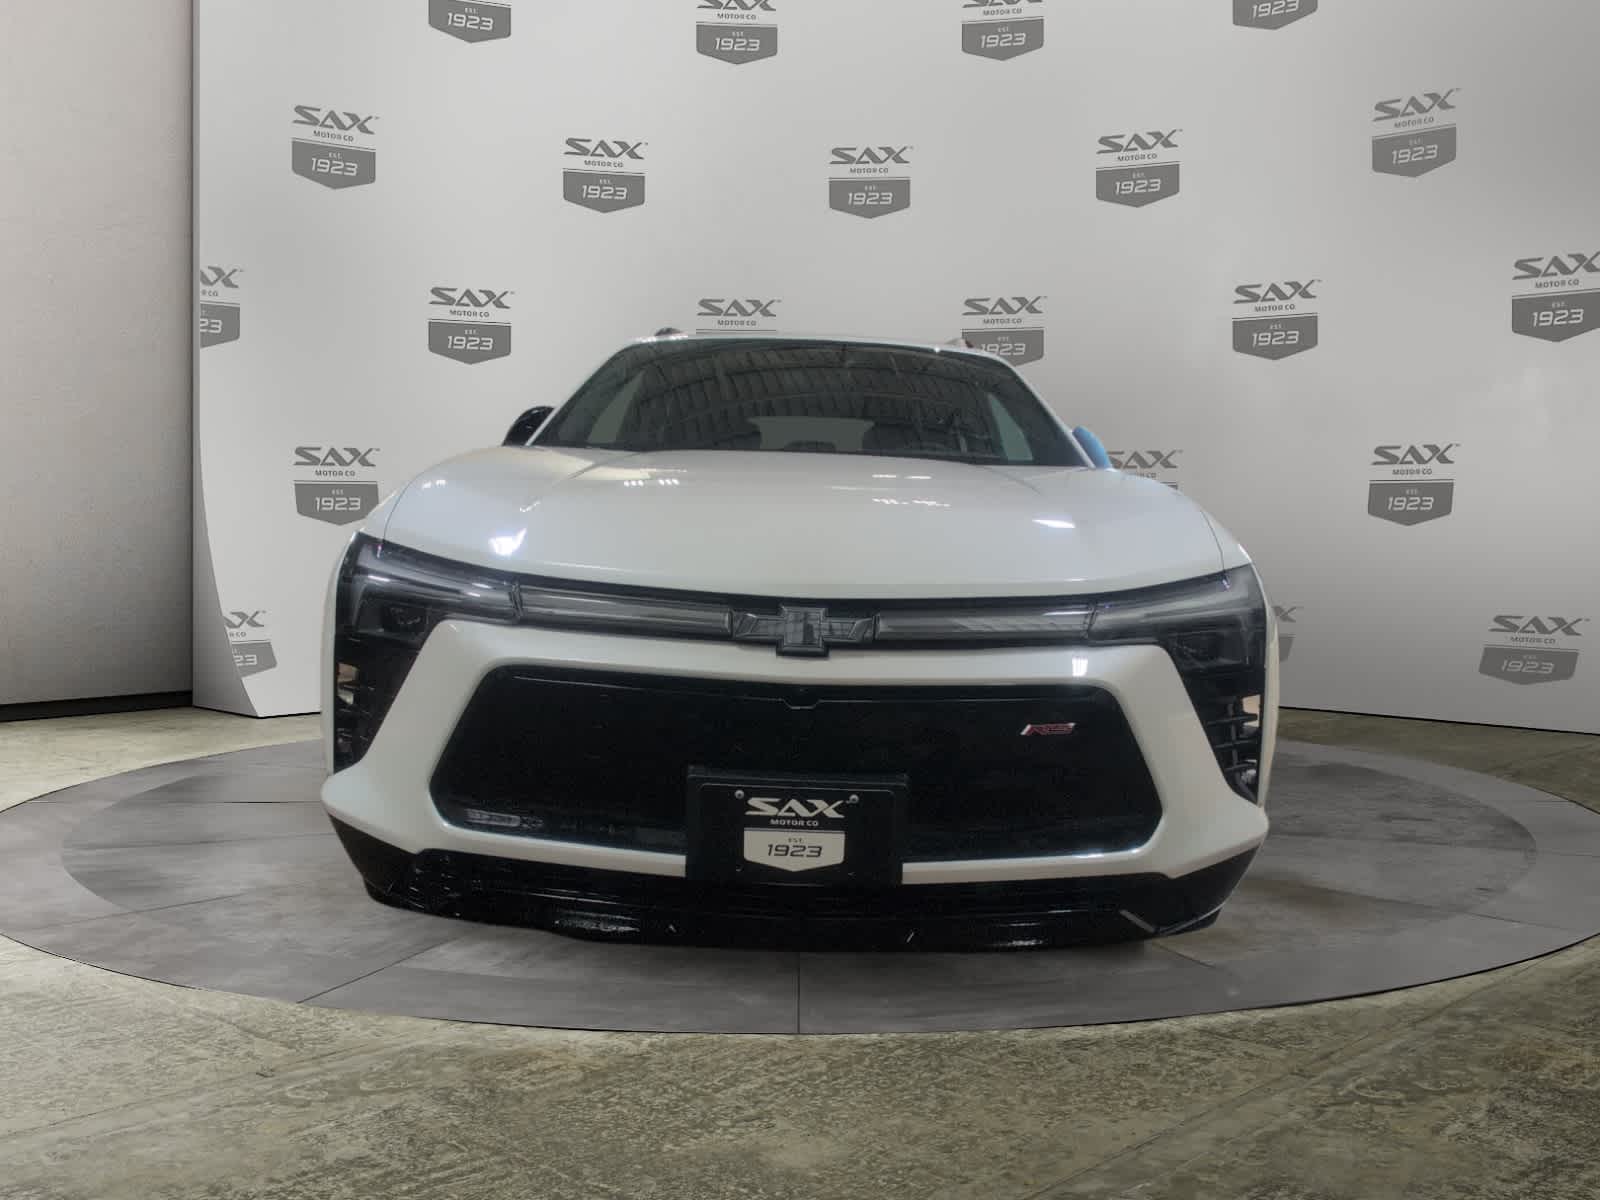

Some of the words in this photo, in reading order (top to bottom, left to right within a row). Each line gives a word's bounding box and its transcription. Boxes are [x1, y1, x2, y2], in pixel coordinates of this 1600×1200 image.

[1252, 0, 1299, 19] 1923
[447, 12, 493, 30] 1923
[715, 38, 760, 51] 1923
[981, 33, 1026, 48] 1923
[1372, 88, 1456, 122] SAX
[293, 105, 375, 134] SAX
[1394, 119, 1421, 128] MOTOR
[313, 130, 342, 139] MOTOR
[343, 134, 355, 142] CO
[1096, 129, 1178, 155] SAX
[563, 137, 645, 160] SAX
[829, 146, 911, 165] SAX
[1392, 144, 1439, 164] 1923
[311, 157, 358, 176] 1923
[583, 160, 612, 168] MOTOR
[1118, 154, 1144, 162] MOTOR
[581, 185, 628, 200] 1923
[1115, 178, 1161, 195] 1923
[847, 192, 893, 205] 1923
[1512, 251, 1600, 280] SAX
[1233, 279, 1318, 304] SAX
[1535, 280, 1566, 288] MOTOR
[428, 286, 511, 309] SAX
[962, 296, 1043, 315] SAX
[697, 298, 777, 317] SAX
[1255, 304, 1282, 312] MOTOR
[200, 318, 222, 333] 23
[1532, 308, 1584, 327] 1923
[447, 335, 493, 350] 1923
[1252, 330, 1299, 347] 1923
[294, 446, 376, 467] SAX
[1372, 443, 1457, 465] SAX
[314, 496, 361, 511] 1923
[1388, 496, 1435, 511] 1923
[1488, 616, 1582, 635] SAX
[233, 654, 257, 666] 23
[1502, 660, 1555, 674] 1923
[745, 797, 845, 818] SAX
[767, 844, 823, 858] 1923
